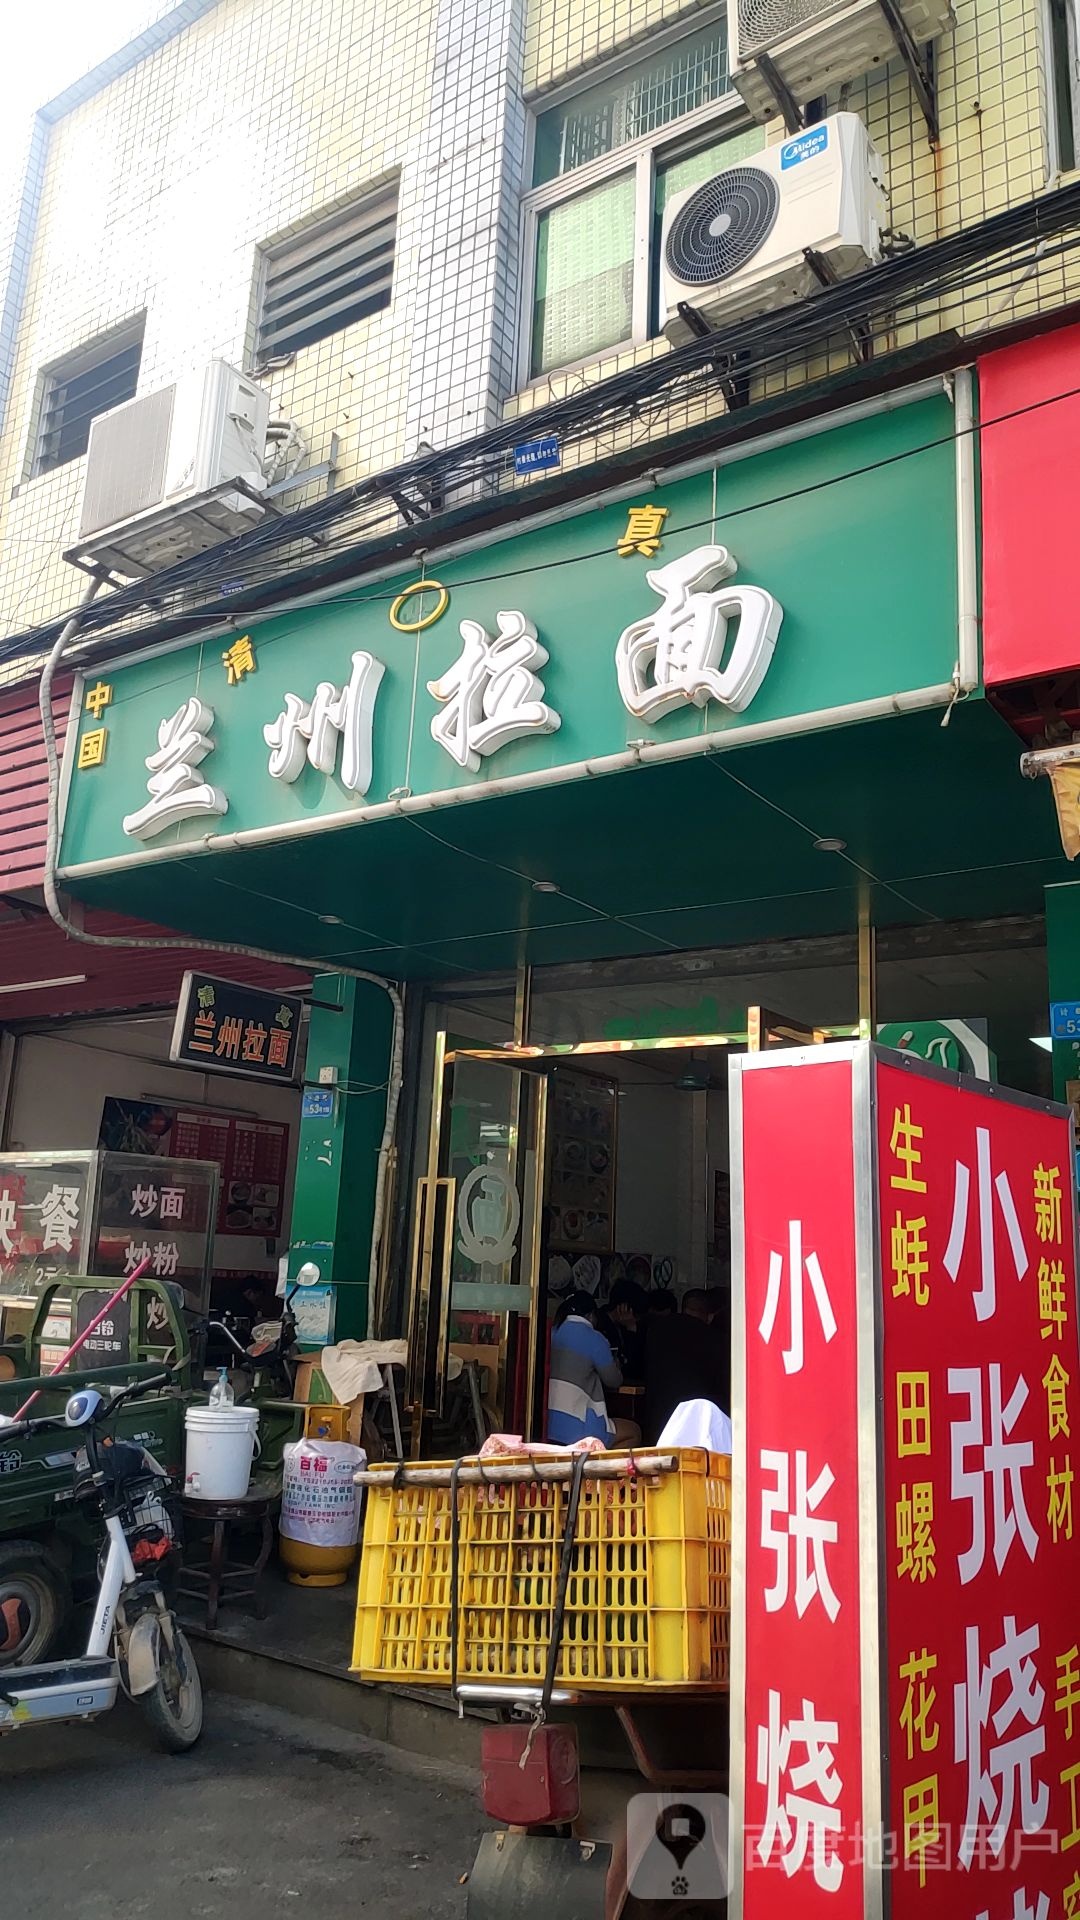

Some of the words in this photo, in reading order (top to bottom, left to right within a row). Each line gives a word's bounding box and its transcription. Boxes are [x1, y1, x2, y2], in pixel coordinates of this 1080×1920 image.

[786, 134, 825, 158] Midea
[222, 634, 258, 686] 清
[616, 504, 671, 558] 真
[77, 681, 113, 770] 中国
[122, 544, 784, 841] 兰州拉面
[188, 1009, 292, 1069] 兰州拉面
[123, 1240, 180, 1276] 炒粉
[130, 1183, 186, 1220] 炒面
[889, 1103, 931, 1307] 生蚝
[1033, 1161, 1075, 1544] 新鲜食材
[300, 1456, 328, 1472] 百福
[757, 1219, 844, 1894] 小张烧
[895, 1371, 937, 1584] 田螺
[943, 1127, 1051, 1920] 小张烧
[898, 1647, 941, 1889] 花甲
